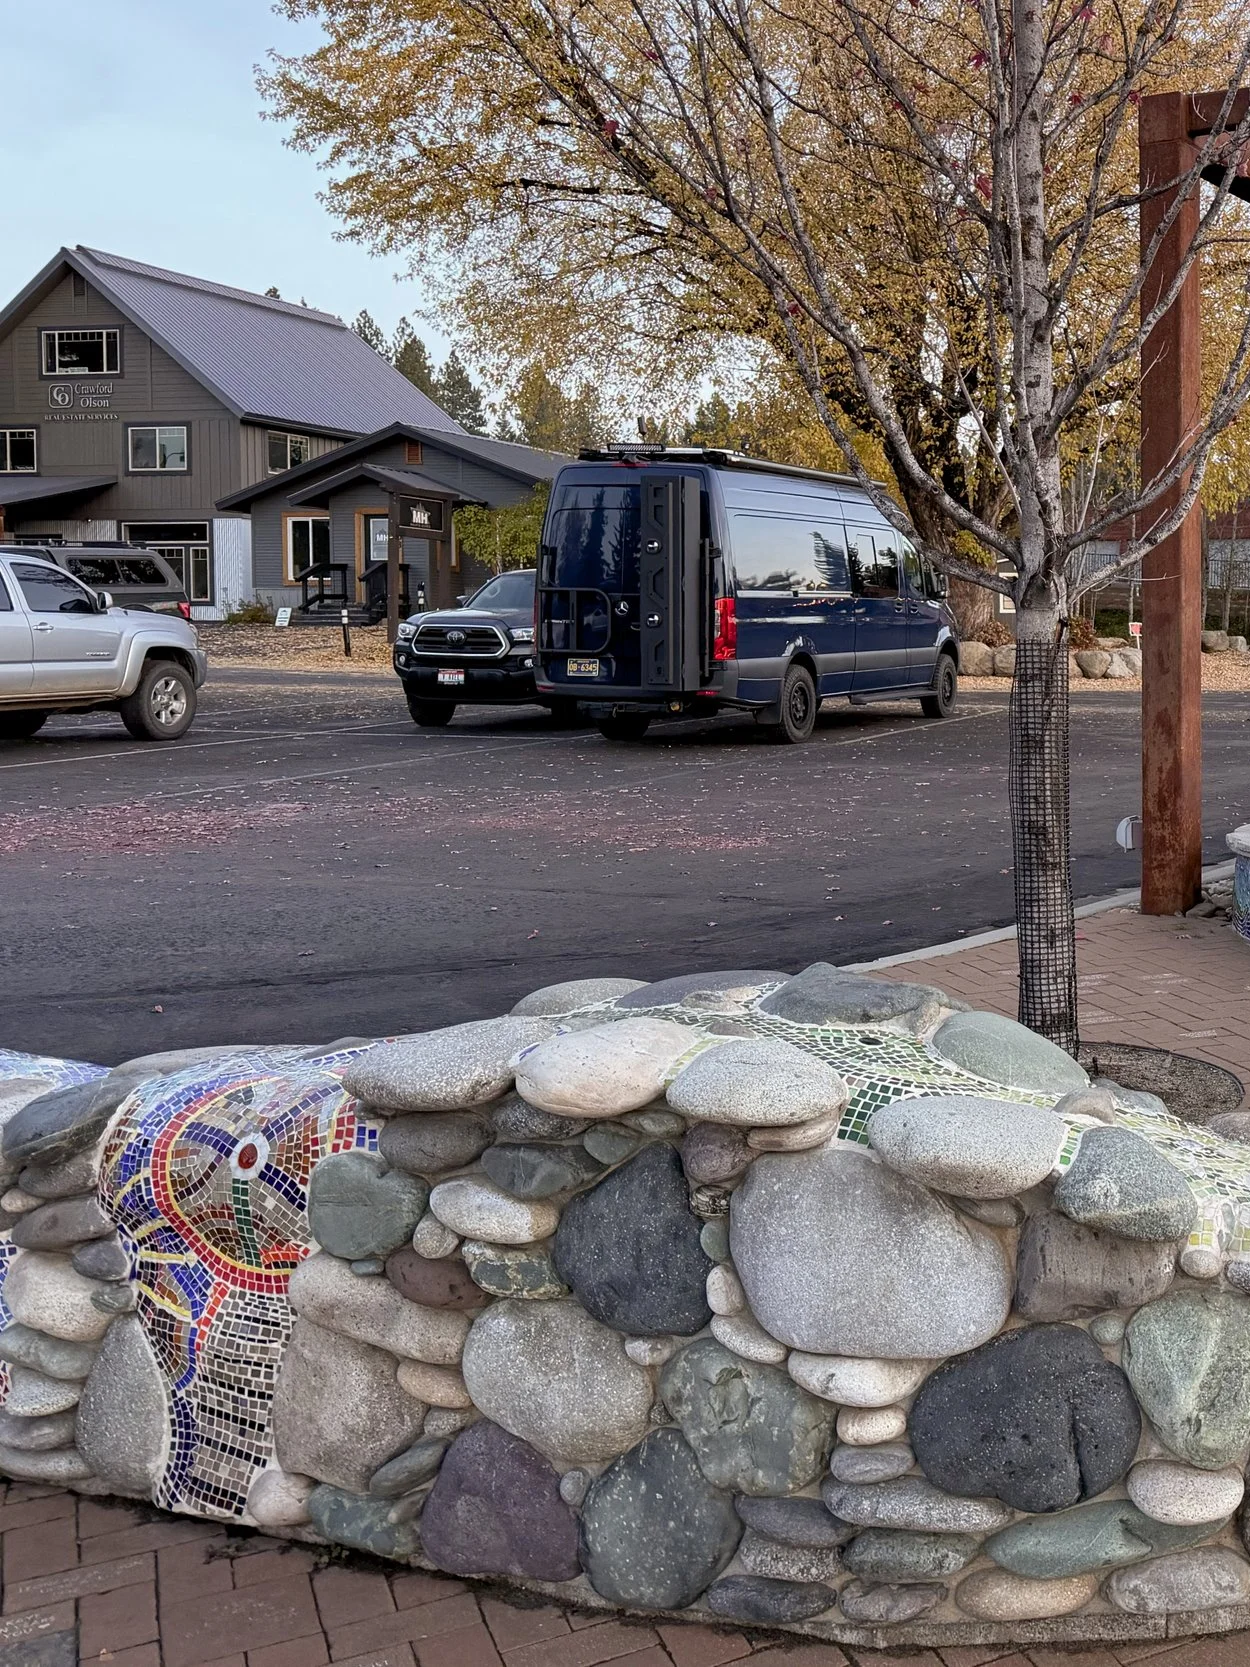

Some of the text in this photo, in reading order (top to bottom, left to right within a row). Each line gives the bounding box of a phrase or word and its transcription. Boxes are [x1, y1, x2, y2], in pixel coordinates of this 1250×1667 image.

[75, 382, 113, 394] Crawford
[80, 397, 109, 408] Olson
[412, 510, 428, 524] MH
